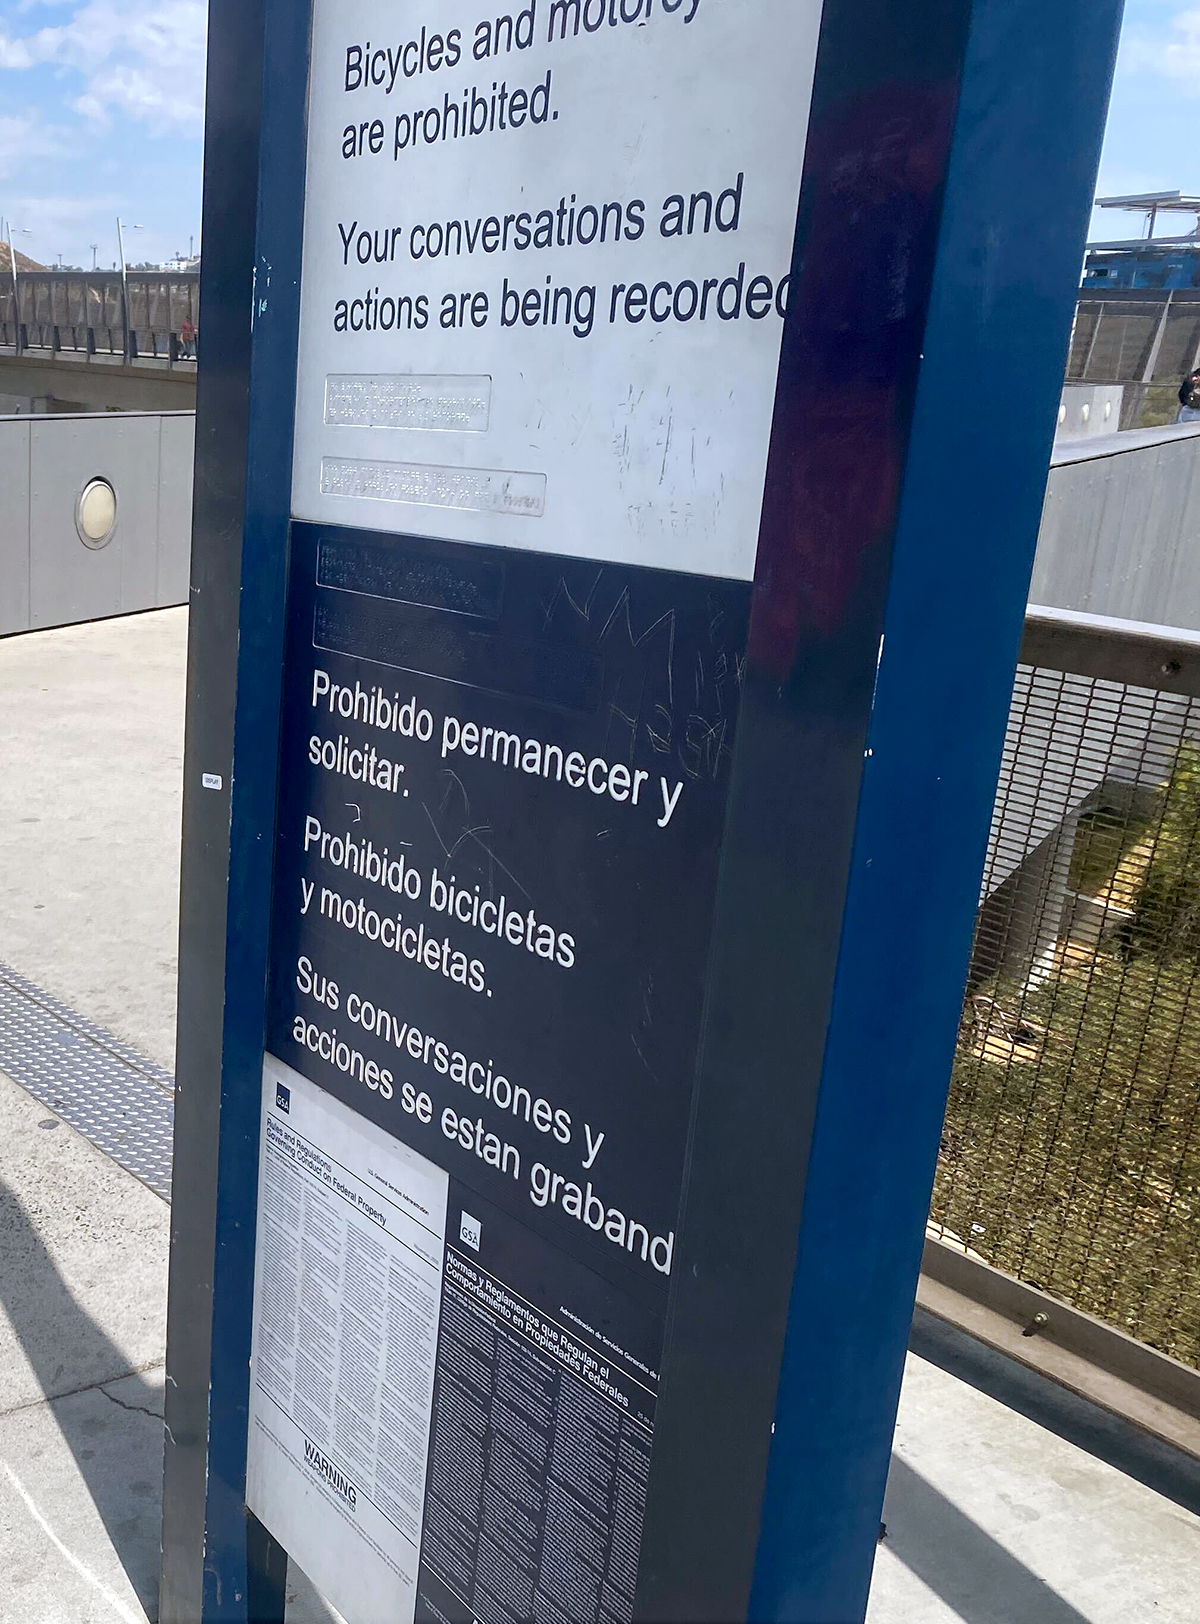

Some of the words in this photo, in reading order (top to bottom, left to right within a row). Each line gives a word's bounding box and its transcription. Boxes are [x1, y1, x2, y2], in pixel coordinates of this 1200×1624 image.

[344, 25, 462, 95] Bicycles
[472, 0, 537, 61] and
[341, 119, 385, 160] are
[393, 69, 559, 162] prohibited.
[337, 220, 402, 266] Your
[409, 193, 646, 260] conversations
[659, 171, 745, 238] and
[333, 285, 429, 333] actions
[439, 291, 489, 330] are
[500, 273, 597, 339] being
[308, 734, 411, 799] solicitar.
[311, 669, 433, 742] Prohibido
[441, 716, 649, 805] permanecer
[656, 775, 684, 828] y
[300, 877, 315, 915] y
[320, 886, 495, 998] motocicletas.
[304, 815, 421, 901] Prohibido
[429, 866, 576, 968] bicicletas
[276, 1094, 290, 1111] GSA
[296, 955, 340, 1010] Sus
[346, 993, 572, 1144] conversaciones
[581, 1123, 605, 1169] y
[266, 1117, 284, 1137] Rules
[284, 1131, 296, 1146] and
[296, 1139, 332, 1173] Regulations
[266, 1127, 296, 1158] Governing
[296, 1150, 323, 1177] Conduct
[322, 1171, 332, 1184] on
[332, 1176, 357, 1203] Federal
[357, 1195, 387, 1228] Property
[292, 1014, 394, 1100] acciones
[401, 1082, 433, 1124] se
[441, 1107, 520, 1180] estan
[529, 1161, 675, 1276] graband
[461, 1226, 480, 1248] GSA
[445, 1262, 512, 1319] Comportamiento
[512, 1314, 524, 1329] en
[525, 1321, 581, 1371] Propiedades
[582, 1363, 630, 1408] Federales
[446, 1250, 478, 1282] Normas
[478, 1276, 485, 1289] y
[485, 1279, 540, 1328] Reglamentos
[541, 1323, 559, 1342] que
[560, 1334, 599, 1372] Regulan
[599, 1366, 610, 1380] el
[304, 1438, 357, 1506] WARNING
